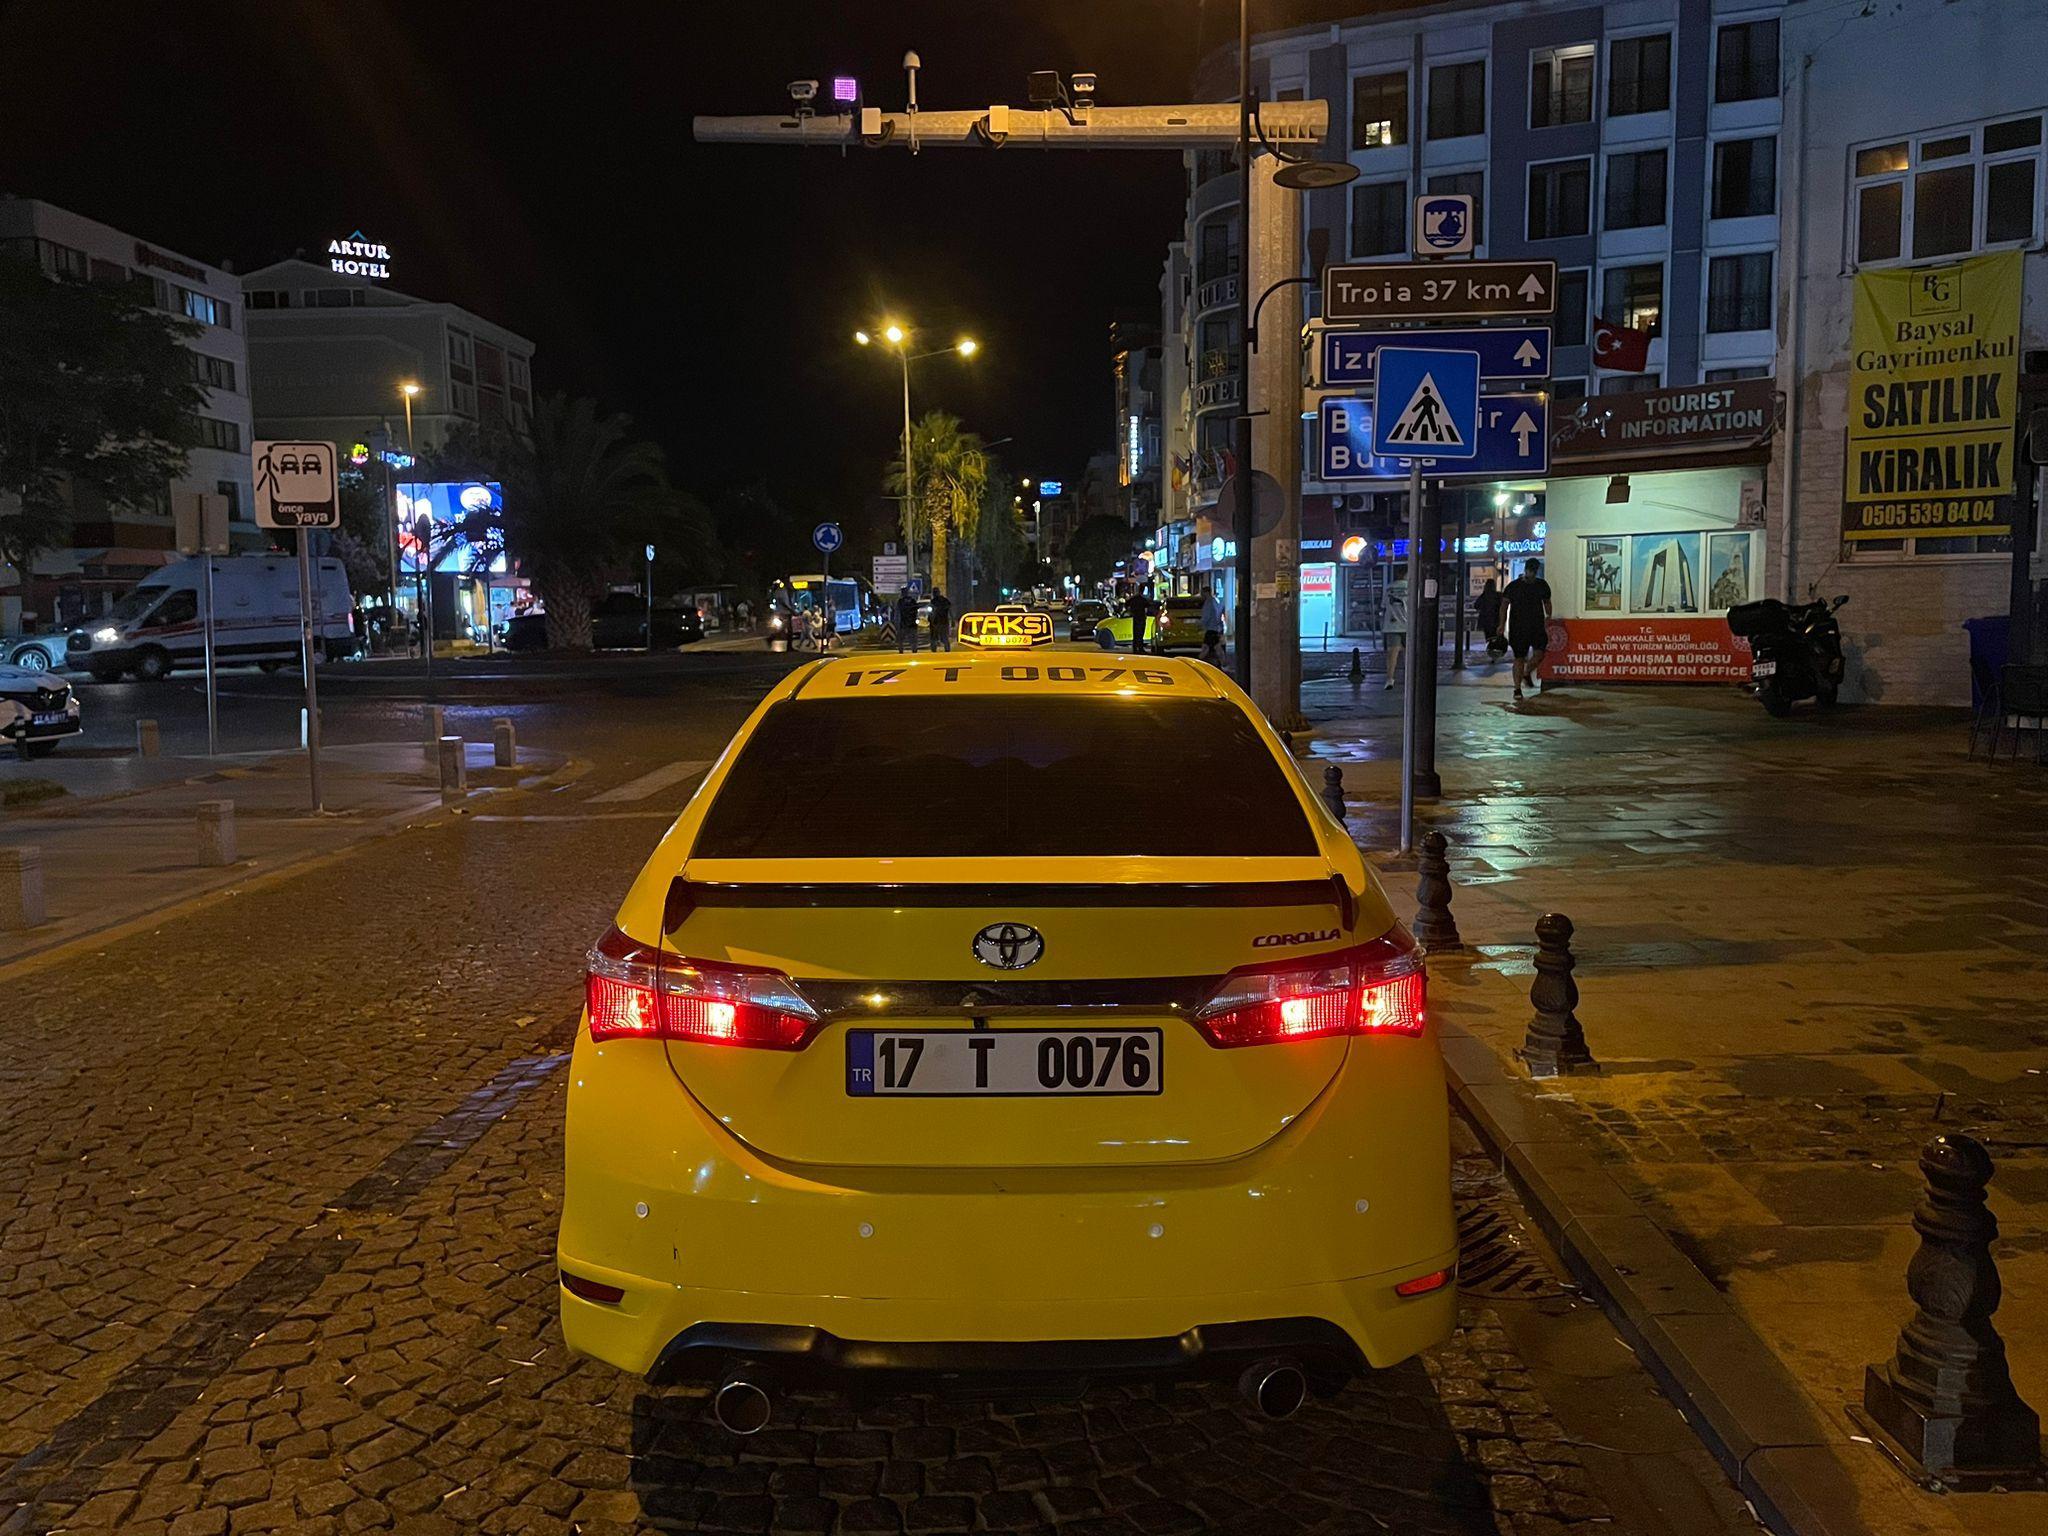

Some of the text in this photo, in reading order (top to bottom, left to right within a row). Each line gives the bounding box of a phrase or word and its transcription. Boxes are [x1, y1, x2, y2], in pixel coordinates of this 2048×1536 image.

[328, 239, 391, 260] ARTUR
[331, 258, 390, 278] HOTEL
[1337, 279, 1511, 303] Troia 37 km
[1896, 314, 1974, 344] Baysal
[1856, 336, 2014, 374] Gayrimenkul
[1644, 390, 1735, 415] TOURIST
[1864, 373, 2001, 429] SATILIK
[1621, 409, 1763, 440] INFORMATION
[278, 503, 304, 513] önce
[296, 512, 328, 525] yaya
[1862, 504, 1907, 526] 0505
[1910, 502, 1944, 525] 539
[1973, 500, 1995, 521] 04
[1587, 642, 1618, 650] KÜLTÜR
[1633, 642, 1663, 650] TURİZM
[1664, 642, 1719, 651] MÜDÜRLÜĞÜ
[1604, 634, 1691, 643] ÇANAKKALE VALİLİĞİ
[1567, 653, 1731, 665] TURİZM DANIŞMA BÜROSU
[844, 666, 1175, 687] 17 T 0076
[1552, 665, 1605, 675] TOURISM
[1609, 666, 1697, 676] INFORMATION
[1700, 666, 1748, 676] OFFICE
[1252, 928, 1341, 948] COROLLA
[852, 1036, 1150, 1088] TR 17 T 0076
